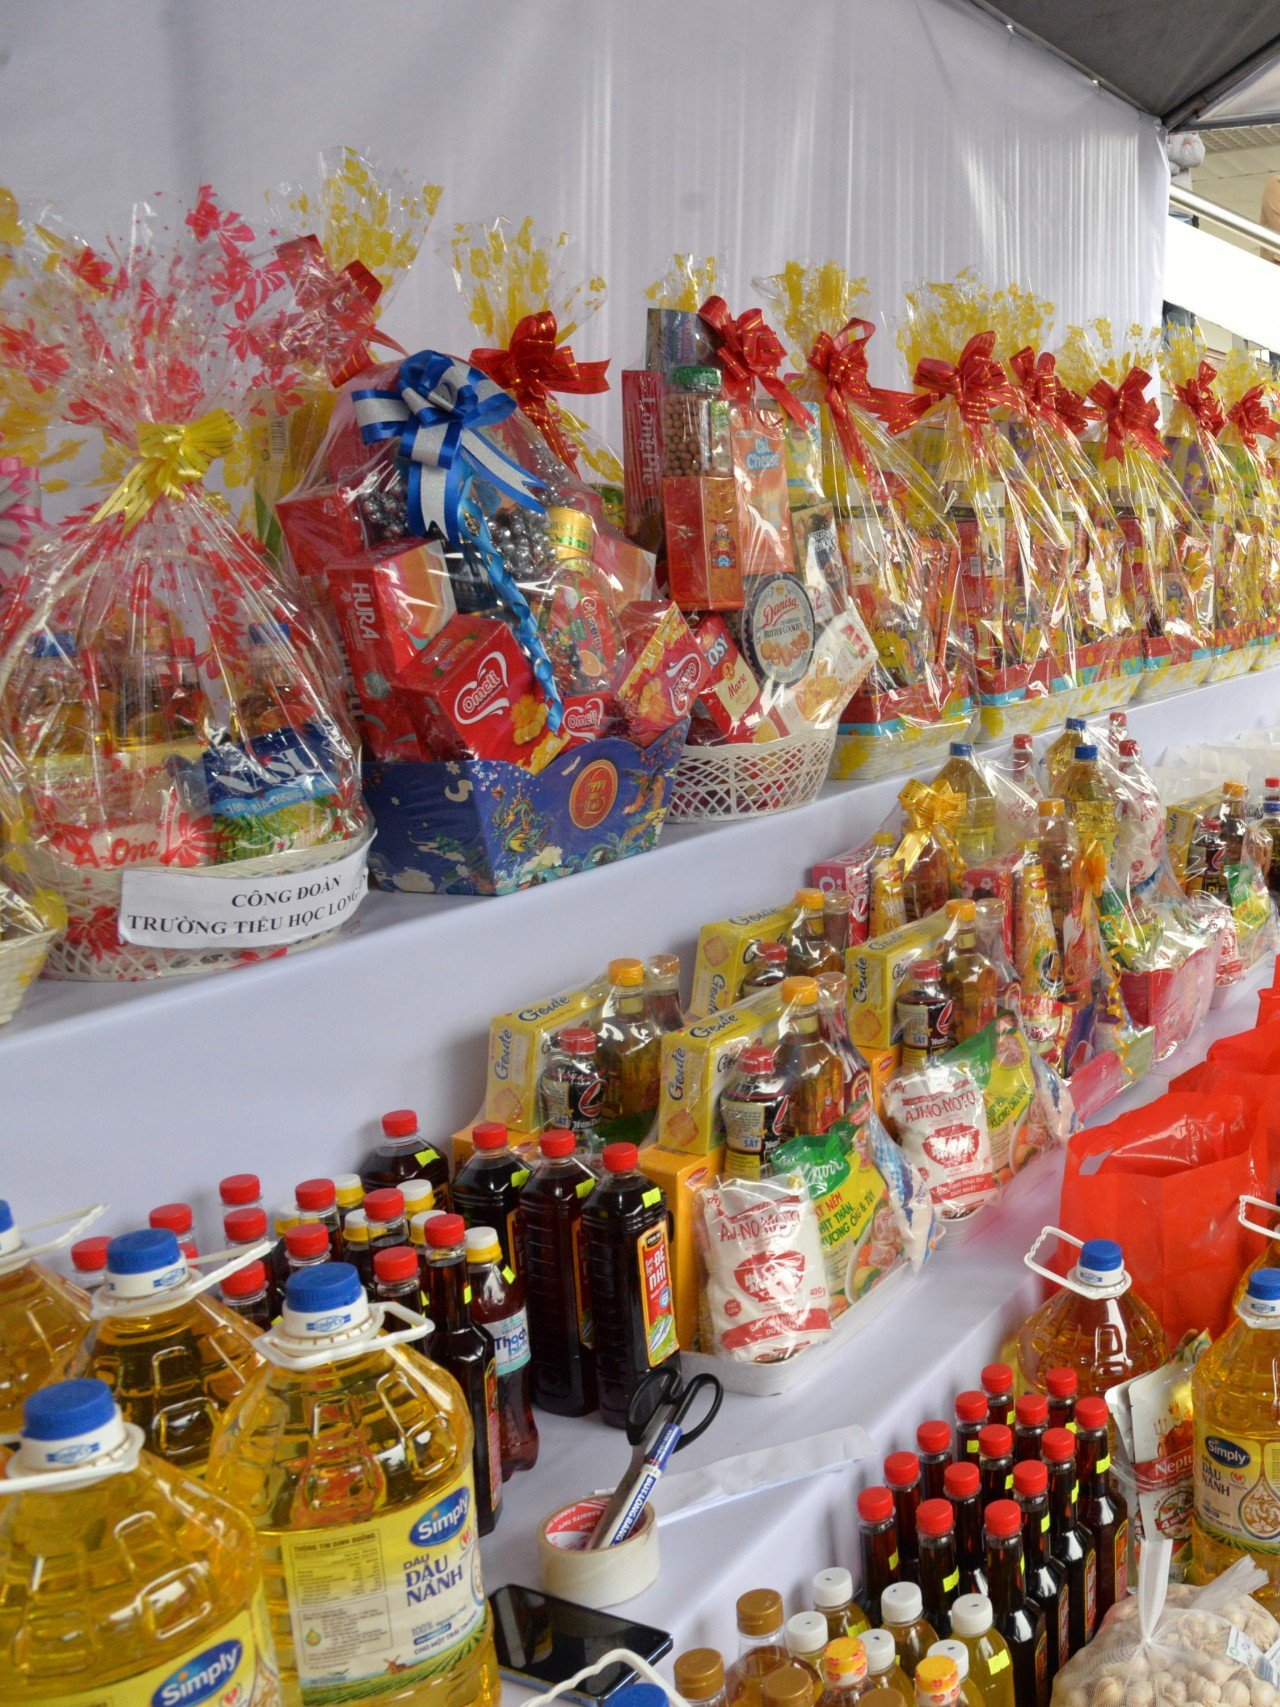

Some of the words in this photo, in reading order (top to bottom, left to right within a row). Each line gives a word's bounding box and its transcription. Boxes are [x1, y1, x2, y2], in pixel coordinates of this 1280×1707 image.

[352, 582, 381, 639] HURA
[762, 593, 800, 629] Danisa
[706, 634, 730, 666] OSY
[462, 669, 501, 714] Omeli
[231, 889, 292, 908] CÔNG
[297, 874, 342, 901] ĐOÀN
[127, 914, 227, 935] TRƯỜNG
[233, 911, 282, 934] TIỂU
[288, 906, 326, 928] HỌC
[518, 996, 571, 1022] Goute
[690, 1013, 739, 1039] Goute
[494, 1028, 512, 1080] Goute
[668, 1047, 686, 1101] Goute
[1206, 1438, 1247, 1466] Simply
[418, 1494, 470, 1541] Simply
[406, 1555, 449, 1590] ĐẬU
[406, 1564, 463, 1608] NÀNH
[412, 1620, 433, 1636] 100%
[161, 1643, 242, 1706] Simply
